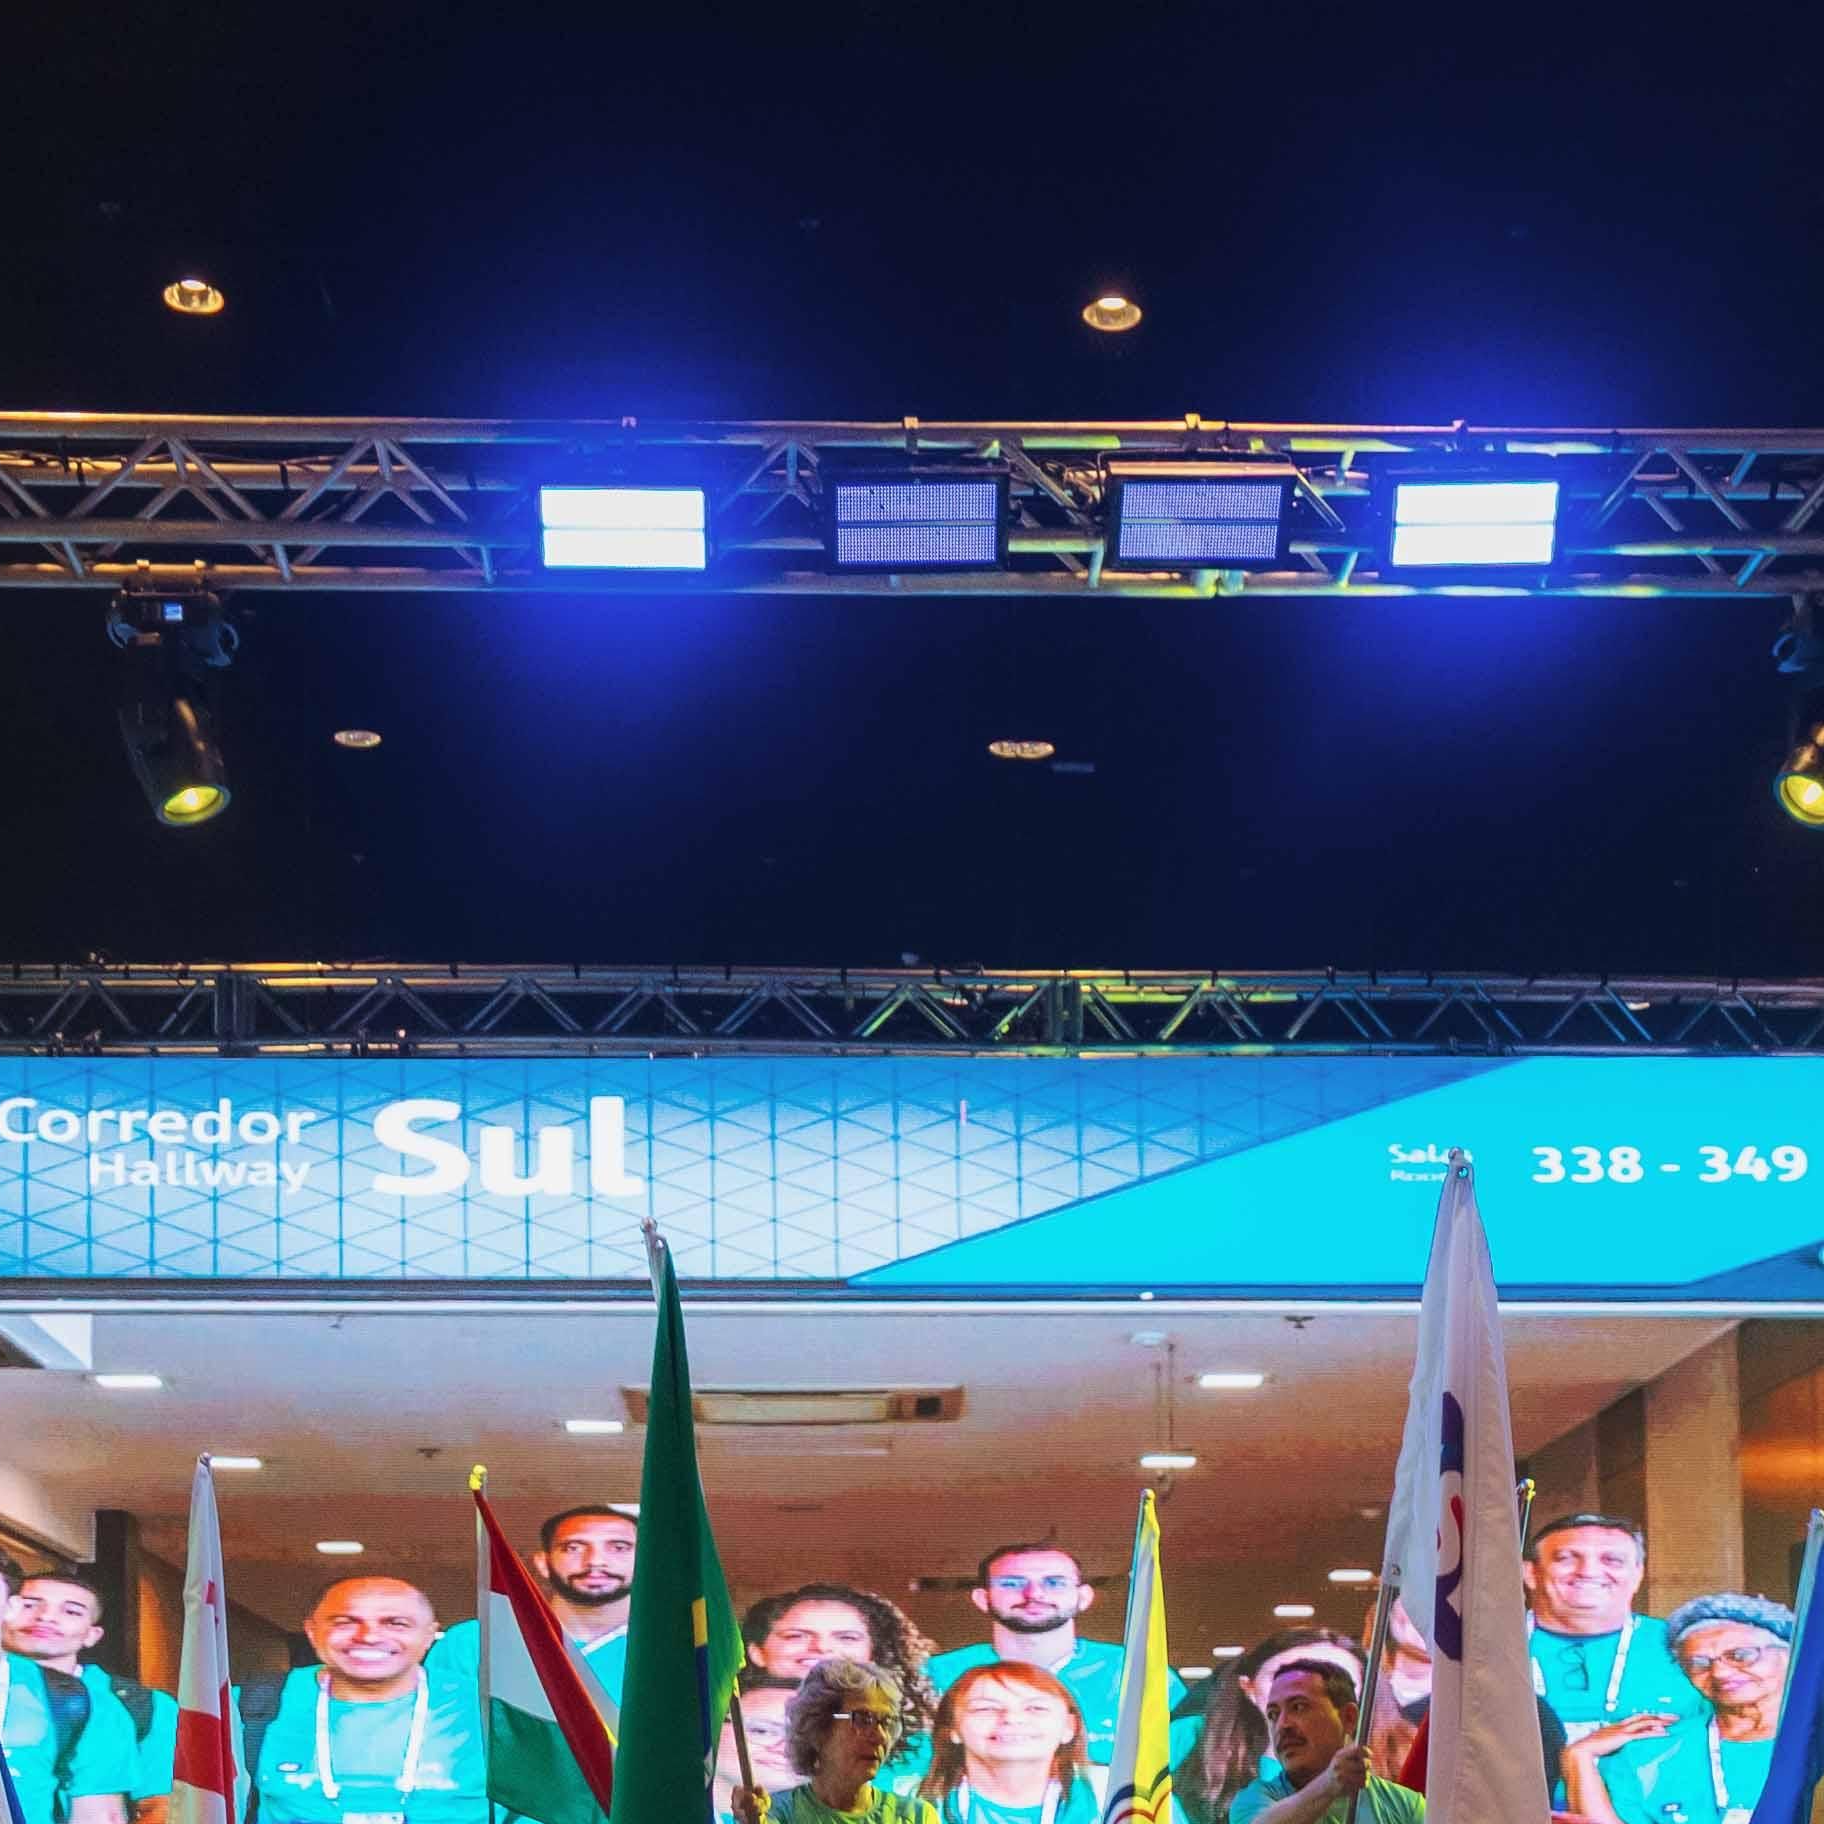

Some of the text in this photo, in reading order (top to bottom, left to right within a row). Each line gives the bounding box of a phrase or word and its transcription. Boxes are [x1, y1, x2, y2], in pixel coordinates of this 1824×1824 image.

[372, 1095, 647, 1198] Sul
[1531, 1146, 1645, 1184] 338
[1697, 1145, 1809, 1183] 349
[88, 1151, 312, 1194] Hallway
